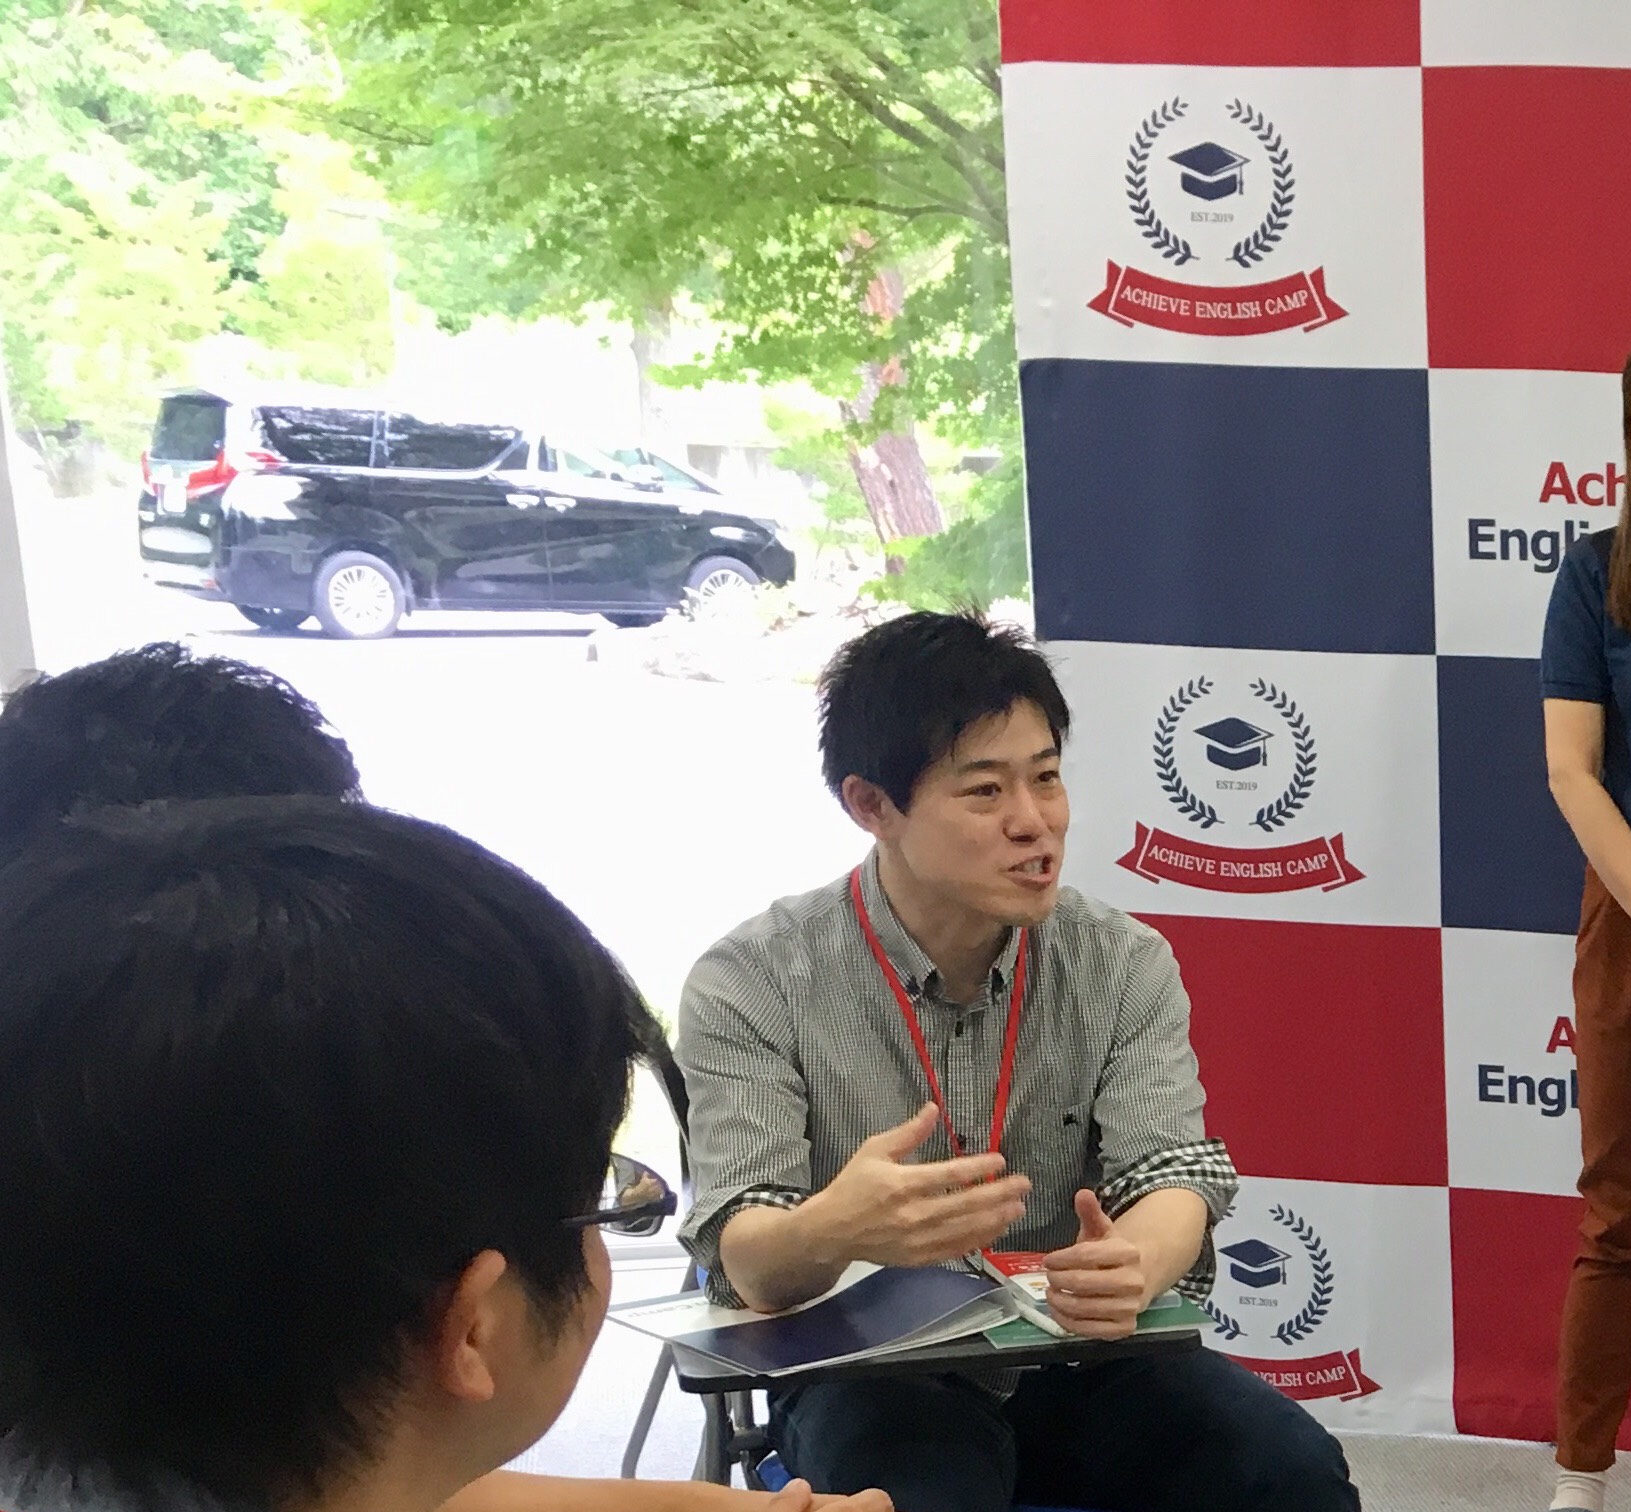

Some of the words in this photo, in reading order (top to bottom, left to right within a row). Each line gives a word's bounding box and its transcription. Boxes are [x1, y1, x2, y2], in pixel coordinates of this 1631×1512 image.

[1121, 285, 1190, 316] ACHIEVE
[1195, 301, 1262, 319] ENGLISH
[1265, 290, 1308, 315] CAMP
[1468, 518, 1590, 573] Engl
[1148, 845, 1216, 875] ACHIEVE
[1220, 861, 1283, 879] ENGLISH
[1286, 854, 1328, 876] CAMP
[1254, 1371, 1302, 1387] NGLISH
[1306, 1366, 1346, 1385] CAMP
